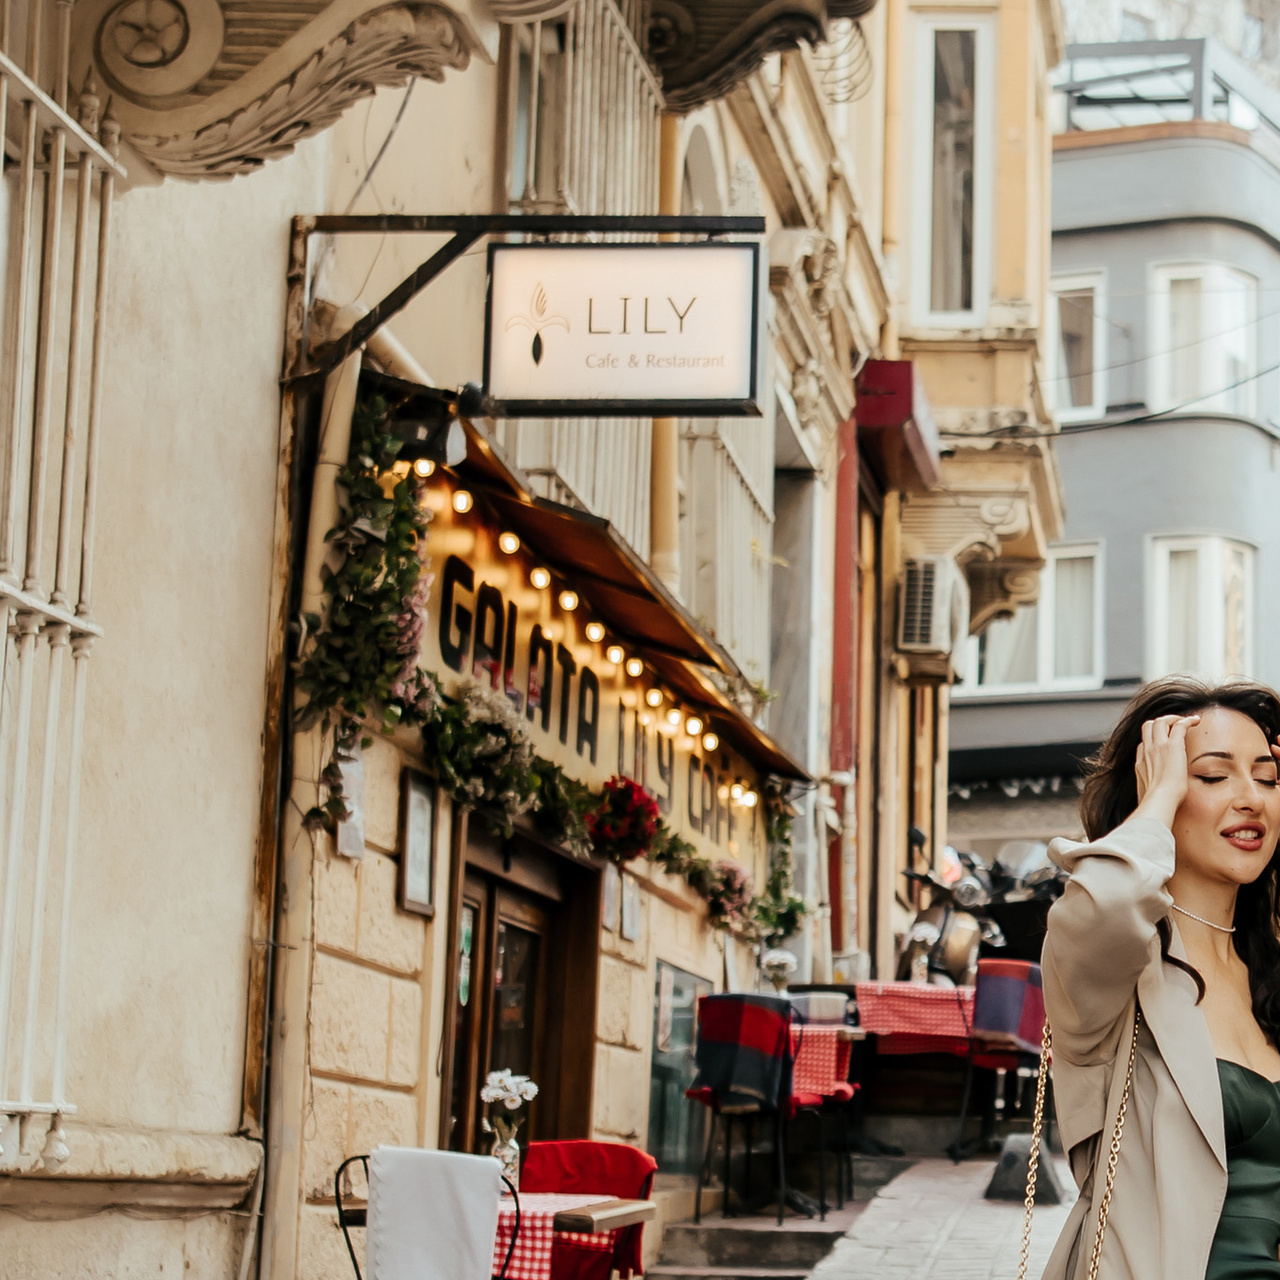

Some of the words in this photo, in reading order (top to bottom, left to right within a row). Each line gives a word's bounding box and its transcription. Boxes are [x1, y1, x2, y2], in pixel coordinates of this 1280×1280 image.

[588, 296, 697, 334] LILY
[585, 354, 619, 368] Cafe
[628, 354, 639, 368] &
[646, 354, 725, 368] Restaurant
[439, 554, 600, 767] GALATA
